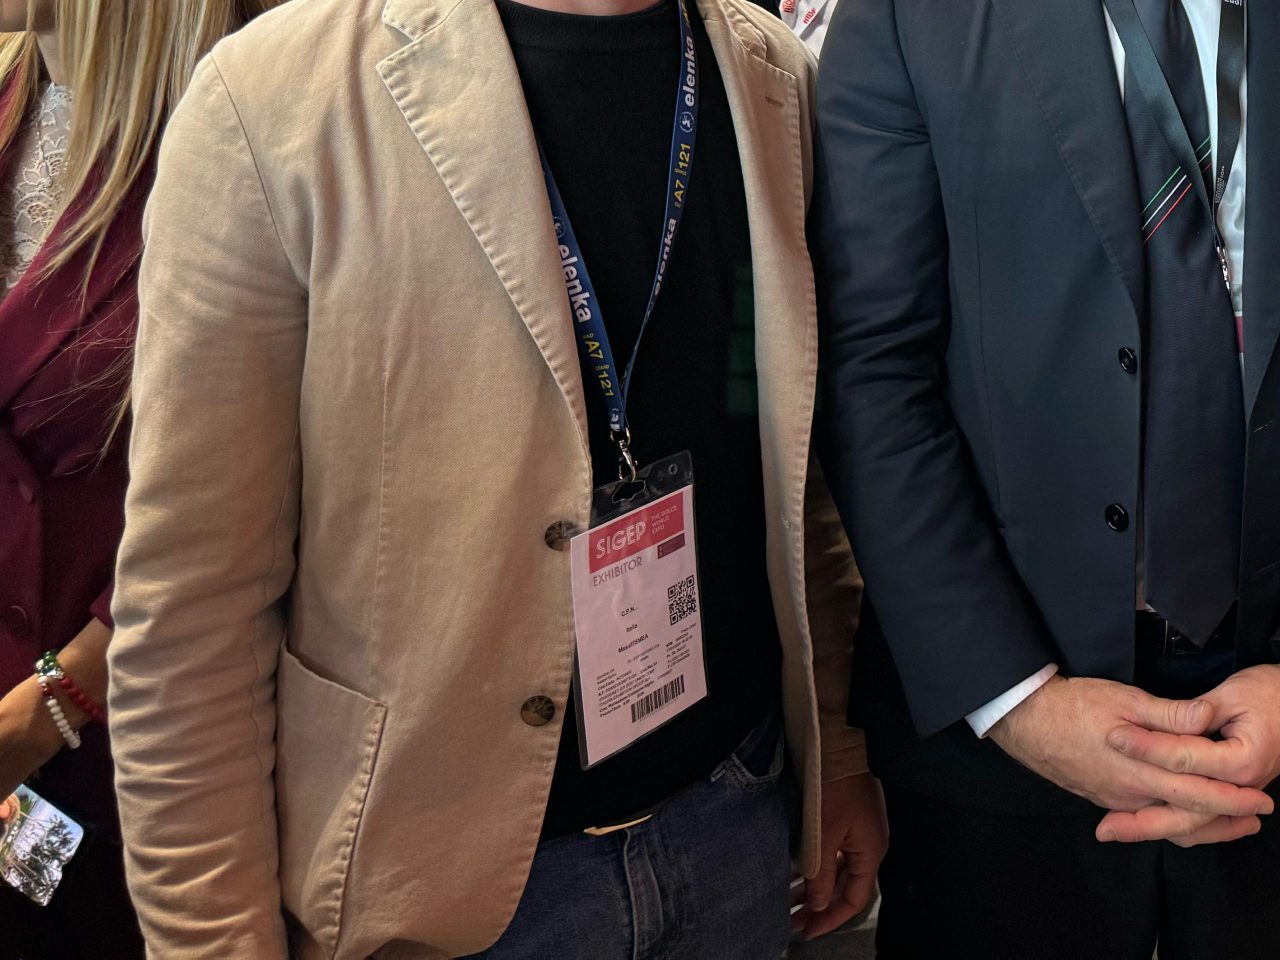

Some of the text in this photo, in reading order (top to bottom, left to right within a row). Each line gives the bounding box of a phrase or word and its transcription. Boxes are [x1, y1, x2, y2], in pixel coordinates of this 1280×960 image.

[682, 36, 696, 107] elenka
[678, 143, 691, 172] 121
[674, 180, 685, 202] A7
[559, 243, 615, 397] elenka A7 121
[595, 521, 646, 559] SIGEP
[593, 556, 643, 587] EXHIBITOR
